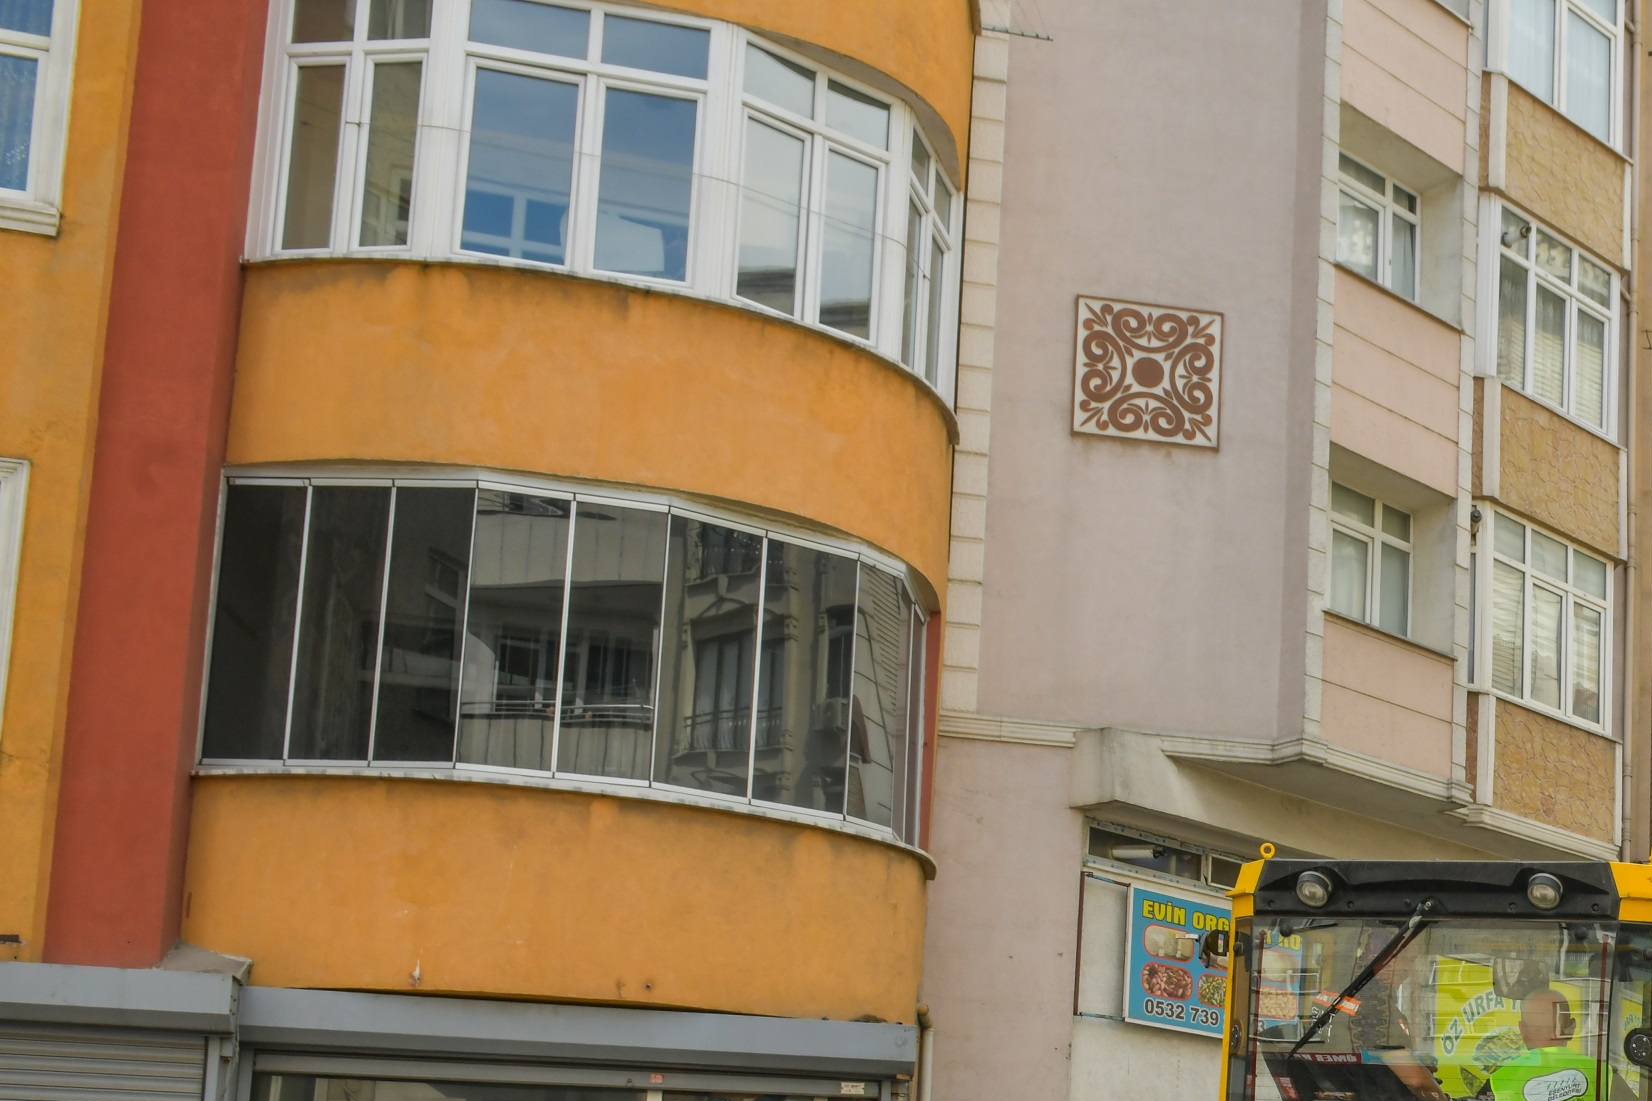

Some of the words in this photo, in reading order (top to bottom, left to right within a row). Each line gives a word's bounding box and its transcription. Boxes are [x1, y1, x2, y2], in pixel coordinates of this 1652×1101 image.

[1142, 899, 1187, 926] EVİN
[1144, 998, 1186, 1020] 0532
[1190, 1006, 1219, 1027] 739
[1441, 1017, 1465, 1056] ÖZ
